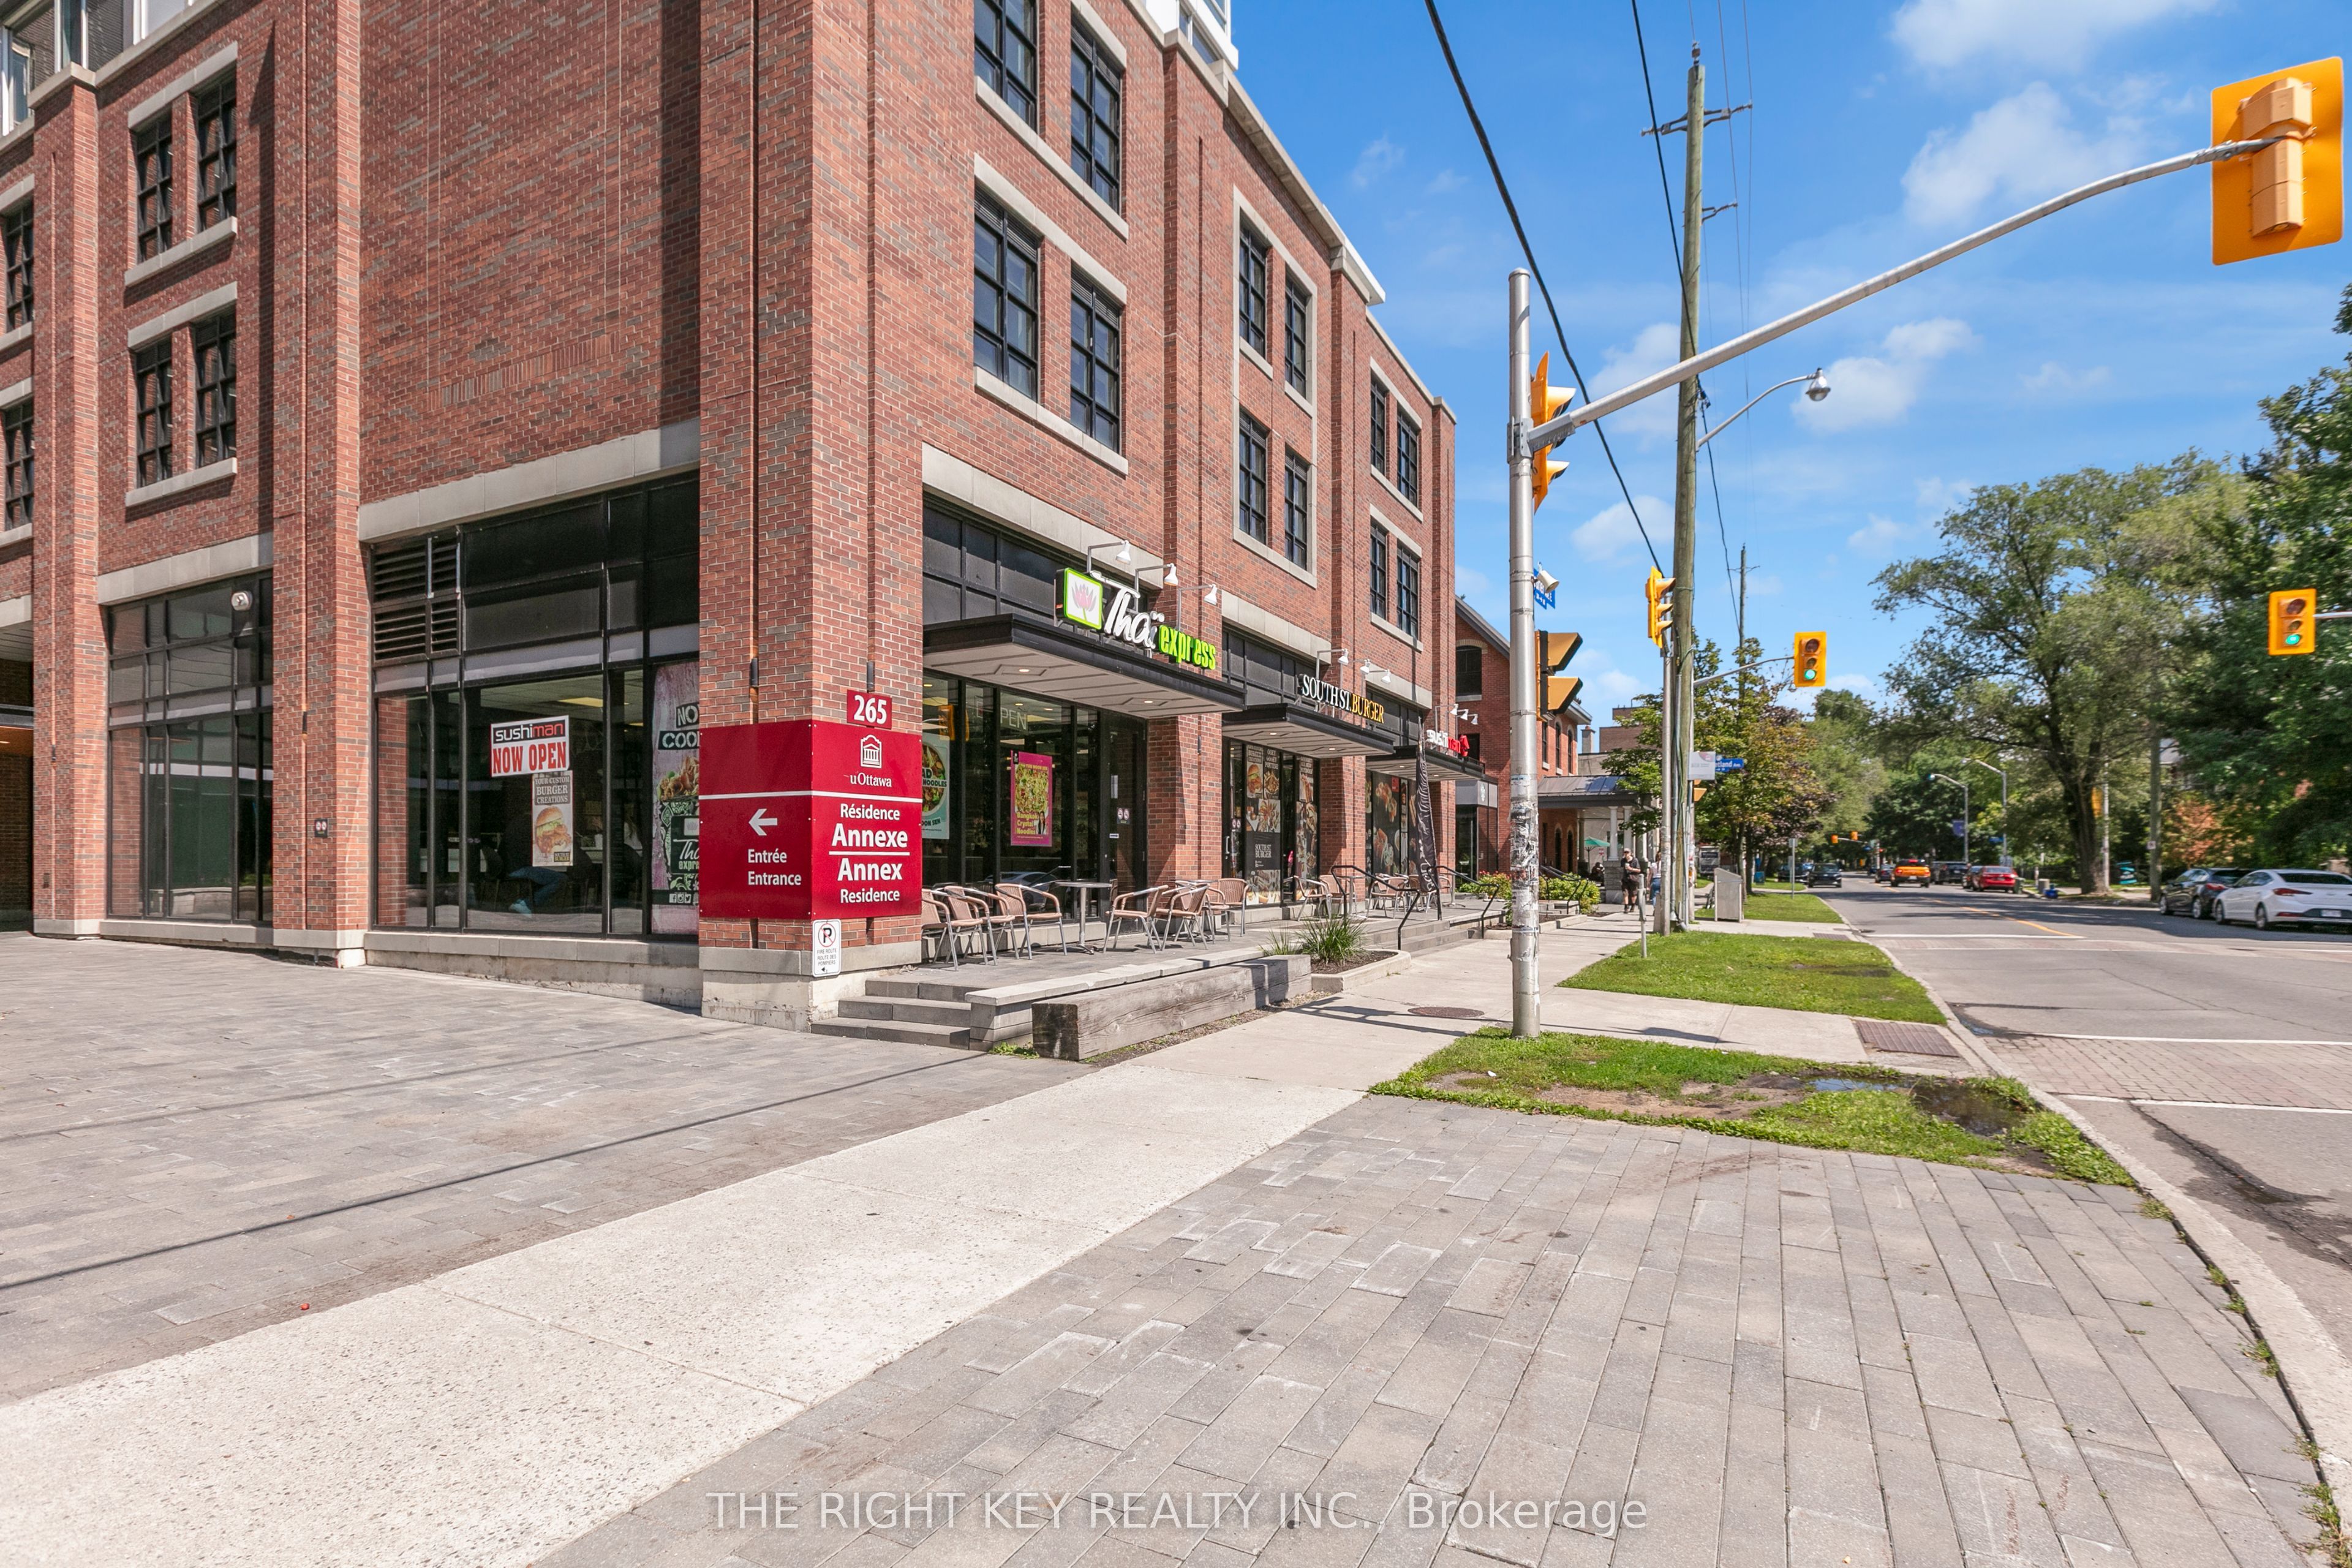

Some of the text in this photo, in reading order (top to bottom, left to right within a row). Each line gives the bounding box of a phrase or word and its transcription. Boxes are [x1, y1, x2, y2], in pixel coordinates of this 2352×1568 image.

[1159, 625, 1216, 671] express
[1302, 674, 1339, 707] SOUTH
[1352, 693, 1384, 724] BURGER
[677, 704, 699, 726] NO
[854, 695, 888, 725] 265
[1000, 707, 1027, 730] PEN
[496, 723, 564, 742] sushiman
[492, 741, 567, 774] NOW OPEN
[850, 772, 892, 788] uOttawa
[537, 785, 568, 796] BURGER
[537, 796, 568, 804] CREATIONS
[840, 803, 900, 821] Résidence
[831, 823, 908, 848] Annexe
[748, 848, 787, 863] Entrée
[748, 871, 802, 886] Entrance
[837, 858, 903, 881] Annex
[840, 888, 900, 903] Residence
[823, 928, 832, 943] P
